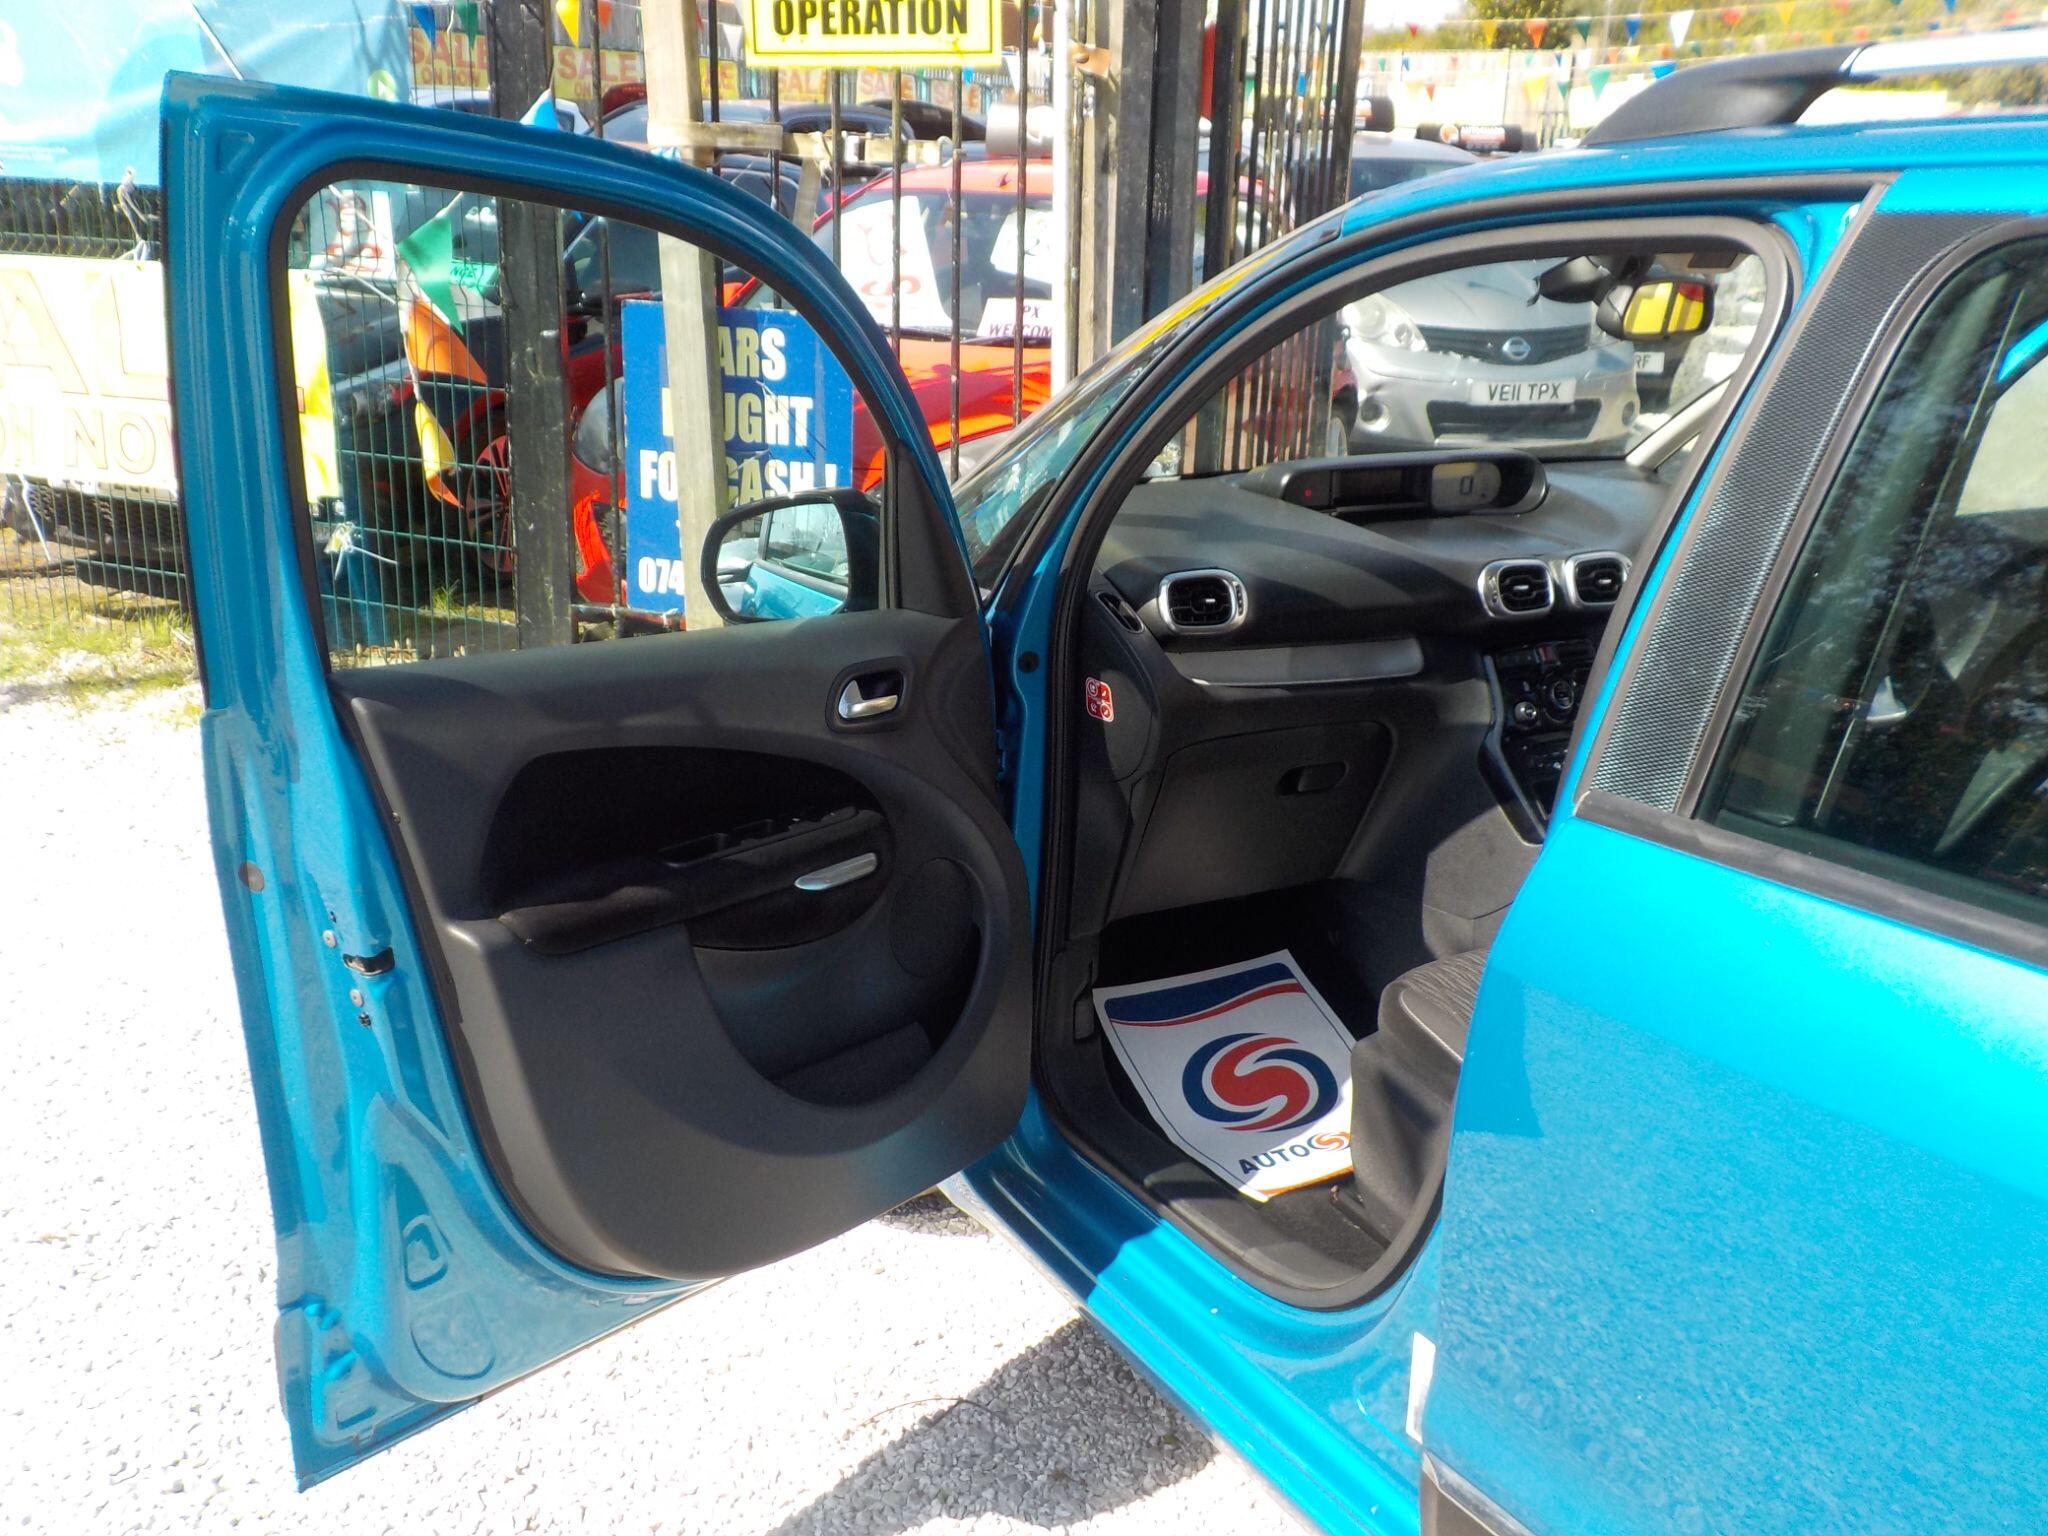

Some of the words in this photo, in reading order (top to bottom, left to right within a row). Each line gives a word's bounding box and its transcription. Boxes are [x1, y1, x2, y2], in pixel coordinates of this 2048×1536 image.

[773, 0, 967, 35] OPERATION
[717, 327, 787, 381] ARS
[1634, 354, 1652, 368] RF
[1528, 382, 1562, 400] TPX
[64, 406, 176, 475] NO
[639, 449, 679, 502] FO
